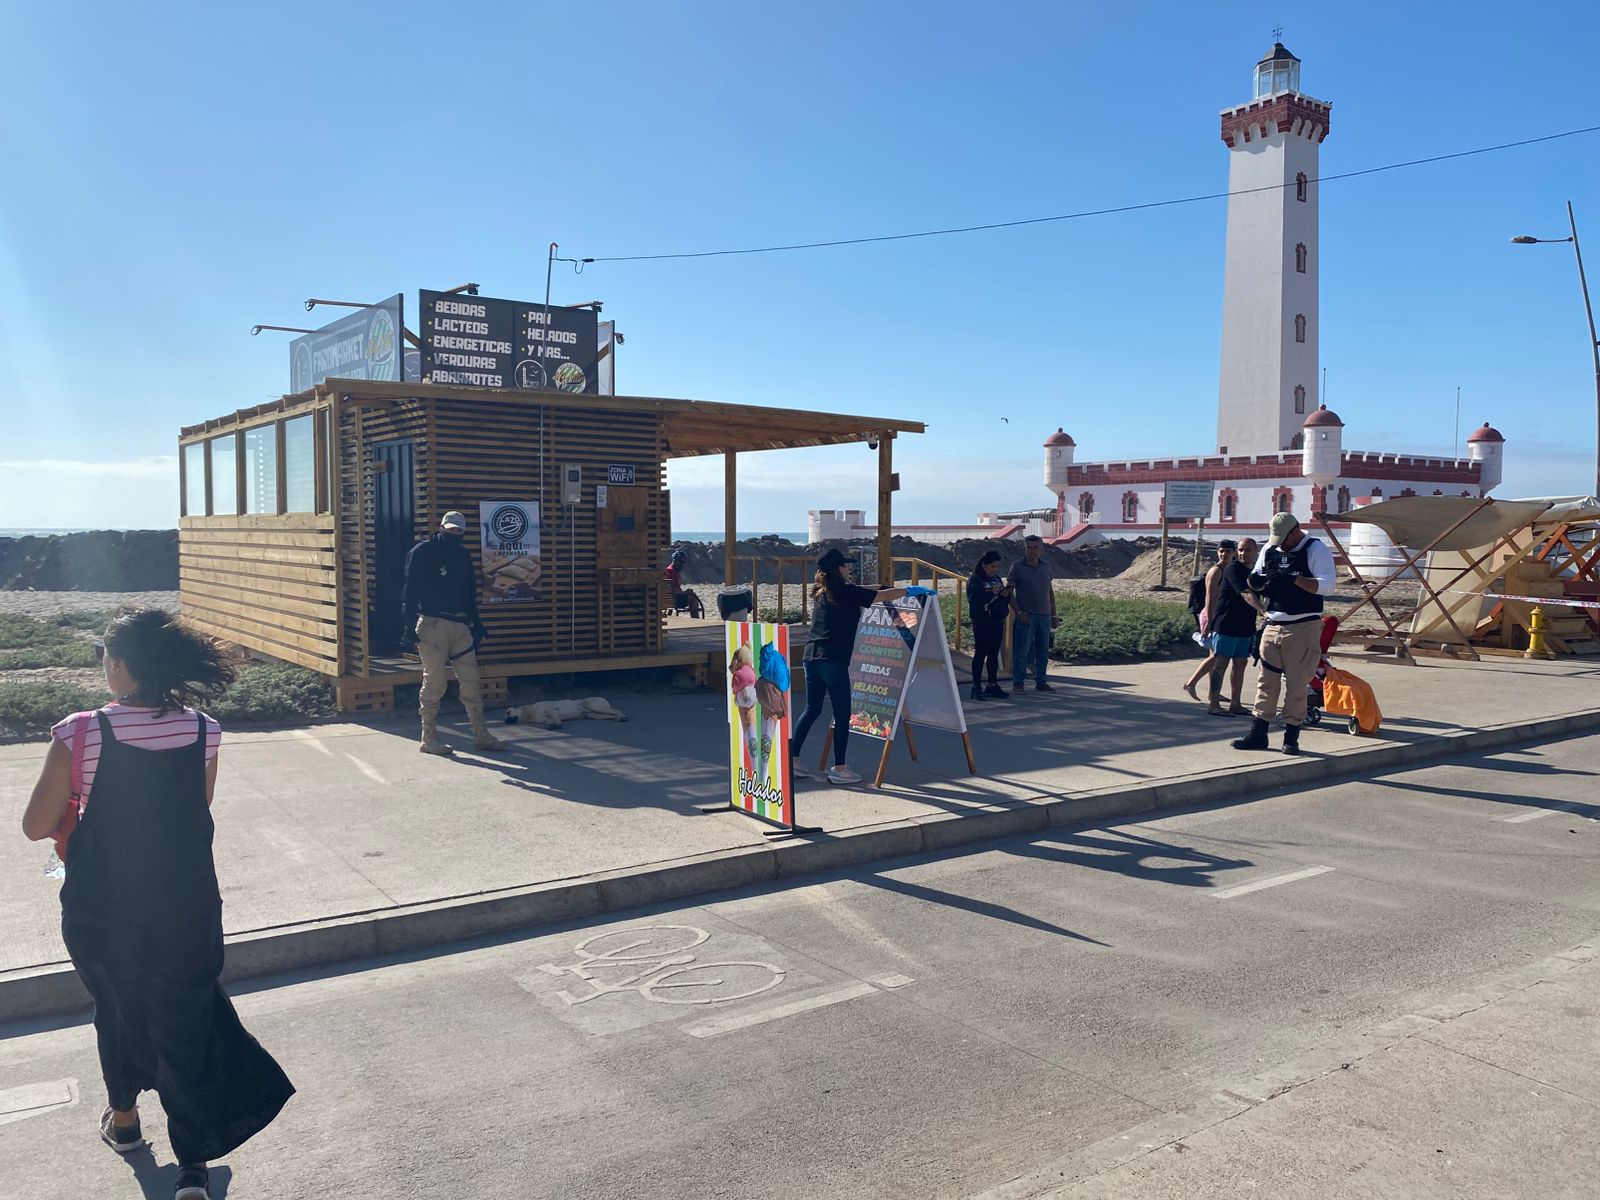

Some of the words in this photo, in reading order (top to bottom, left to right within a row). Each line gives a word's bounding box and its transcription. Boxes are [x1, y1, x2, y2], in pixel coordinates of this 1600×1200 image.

[435, 300, 486, 318] BEBIDAS
[528, 311, 552, 325] PAN
[434, 317, 488, 335] LACTEOS
[433, 335, 513, 354] ENERGETICAS
[527, 327, 577, 344] HELADOS
[527, 344, 535, 356] Y
[433, 352, 497, 370] VERDURAS
[432, 369, 502, 387] ABARROTES
[862, 608, 893, 626] PAN
[860, 663, 891, 676] BEBIDAS
[853, 681, 889, 696] HELADOS
[738, 767, 784, 807] Helados
